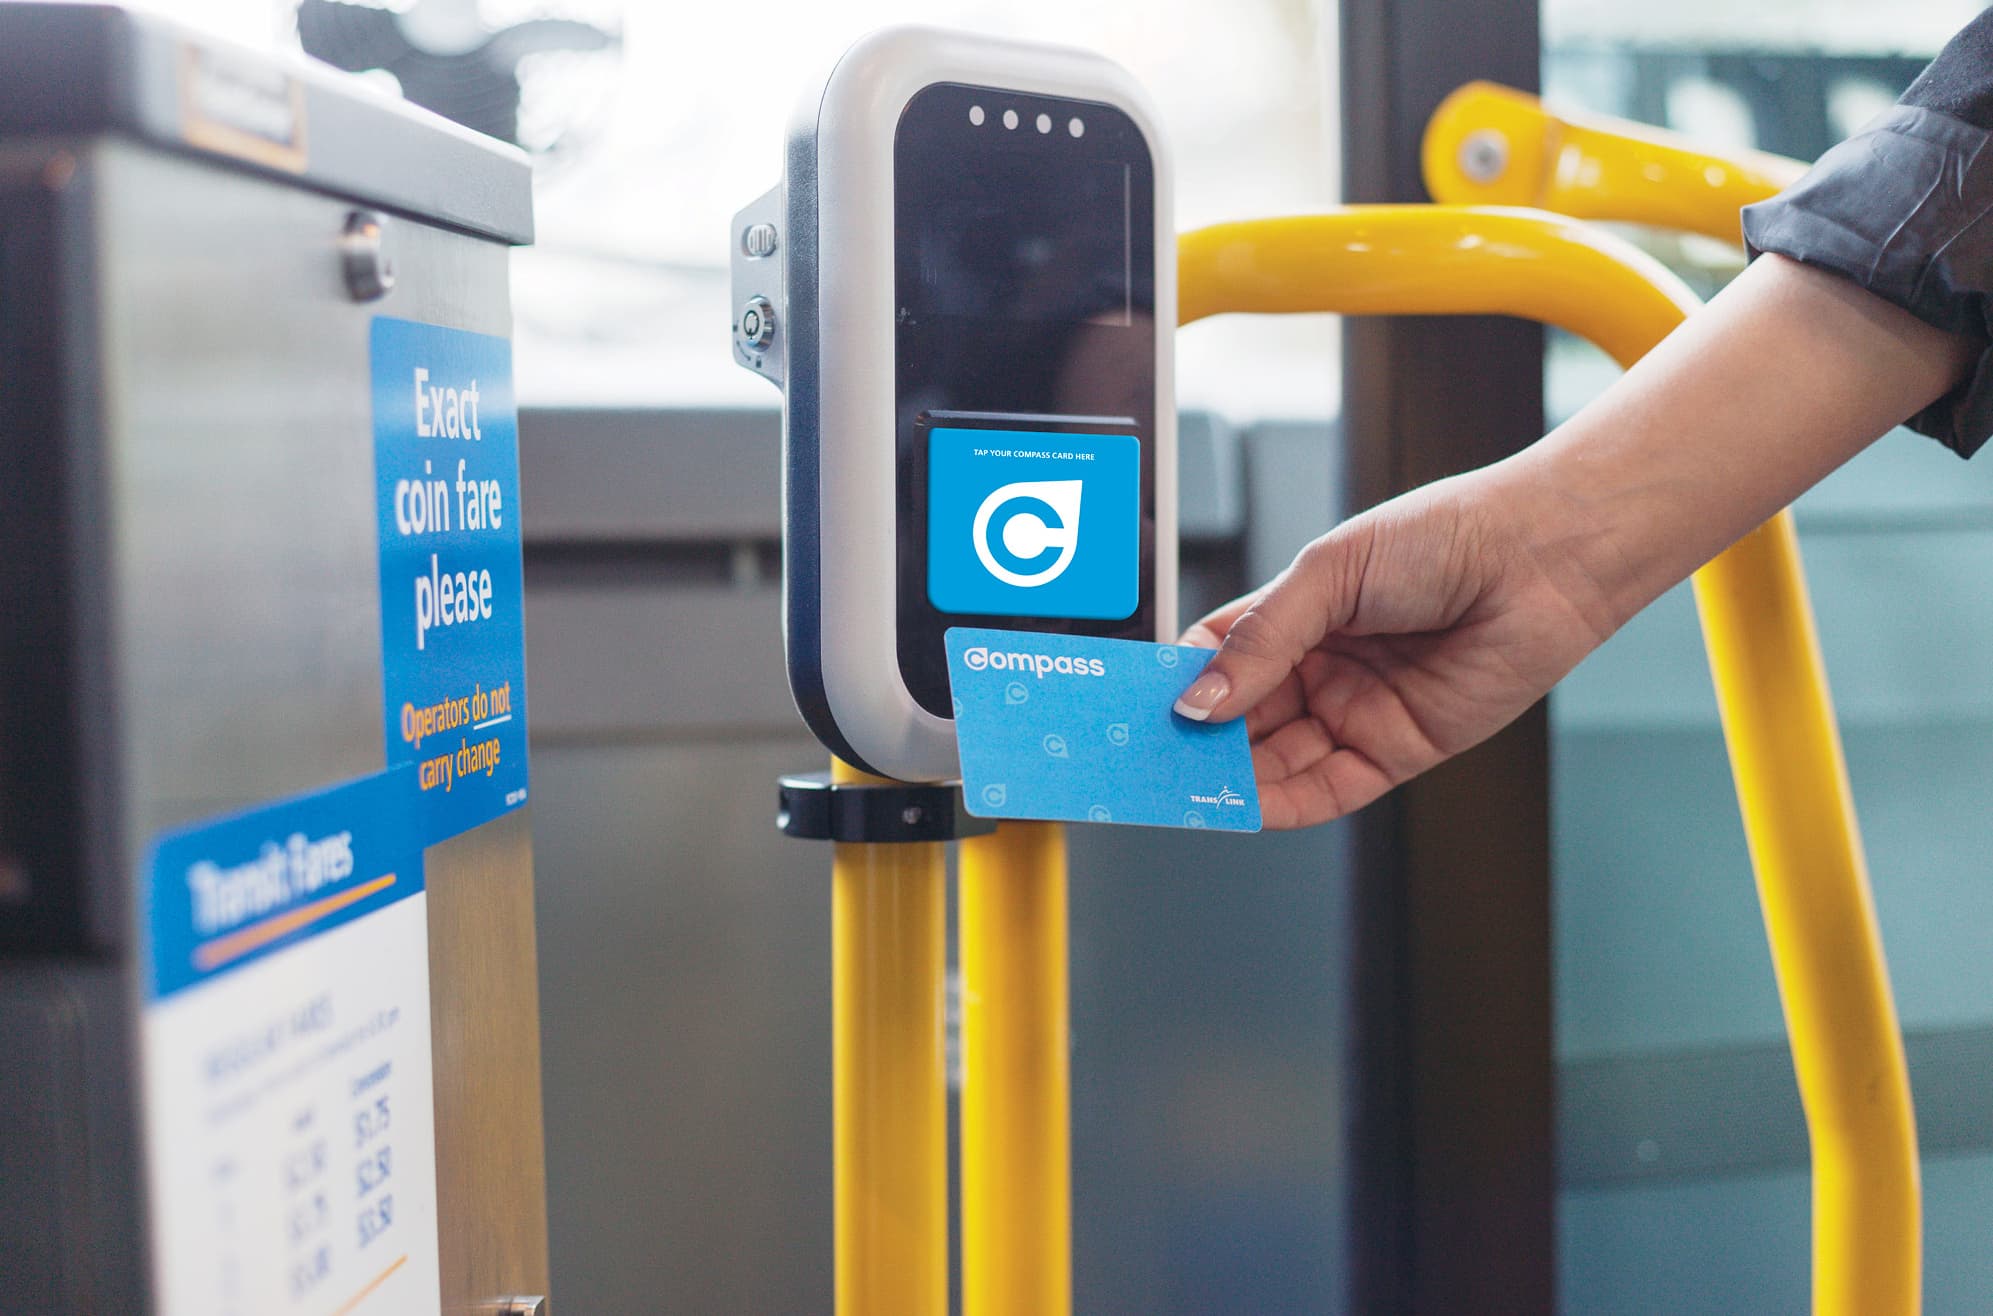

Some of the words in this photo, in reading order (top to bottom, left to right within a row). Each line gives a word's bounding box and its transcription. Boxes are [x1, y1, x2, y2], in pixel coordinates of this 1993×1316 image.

[414, 367, 481, 441] Exact
[973, 448, 988, 456] TAP
[990, 449, 1012, 458] YOUR
[1013, 449, 1050, 460] COMPASS
[1052, 452, 1073, 460] CARD
[1075, 453, 1095, 461] HERE
[395, 459, 450, 535] coin
[456, 458, 503, 531] fare
[414, 554, 493, 650] please
[963, 647, 1105, 679] Compass
[402, 694, 470, 751] Operators
[472, 681, 489, 721] do
[490, 680, 512, 717] not
[419, 753, 454, 793] carry
[456, 736, 501, 777] change
[187, 842, 291, 935] Transit
[287, 831, 353, 897] Fares
